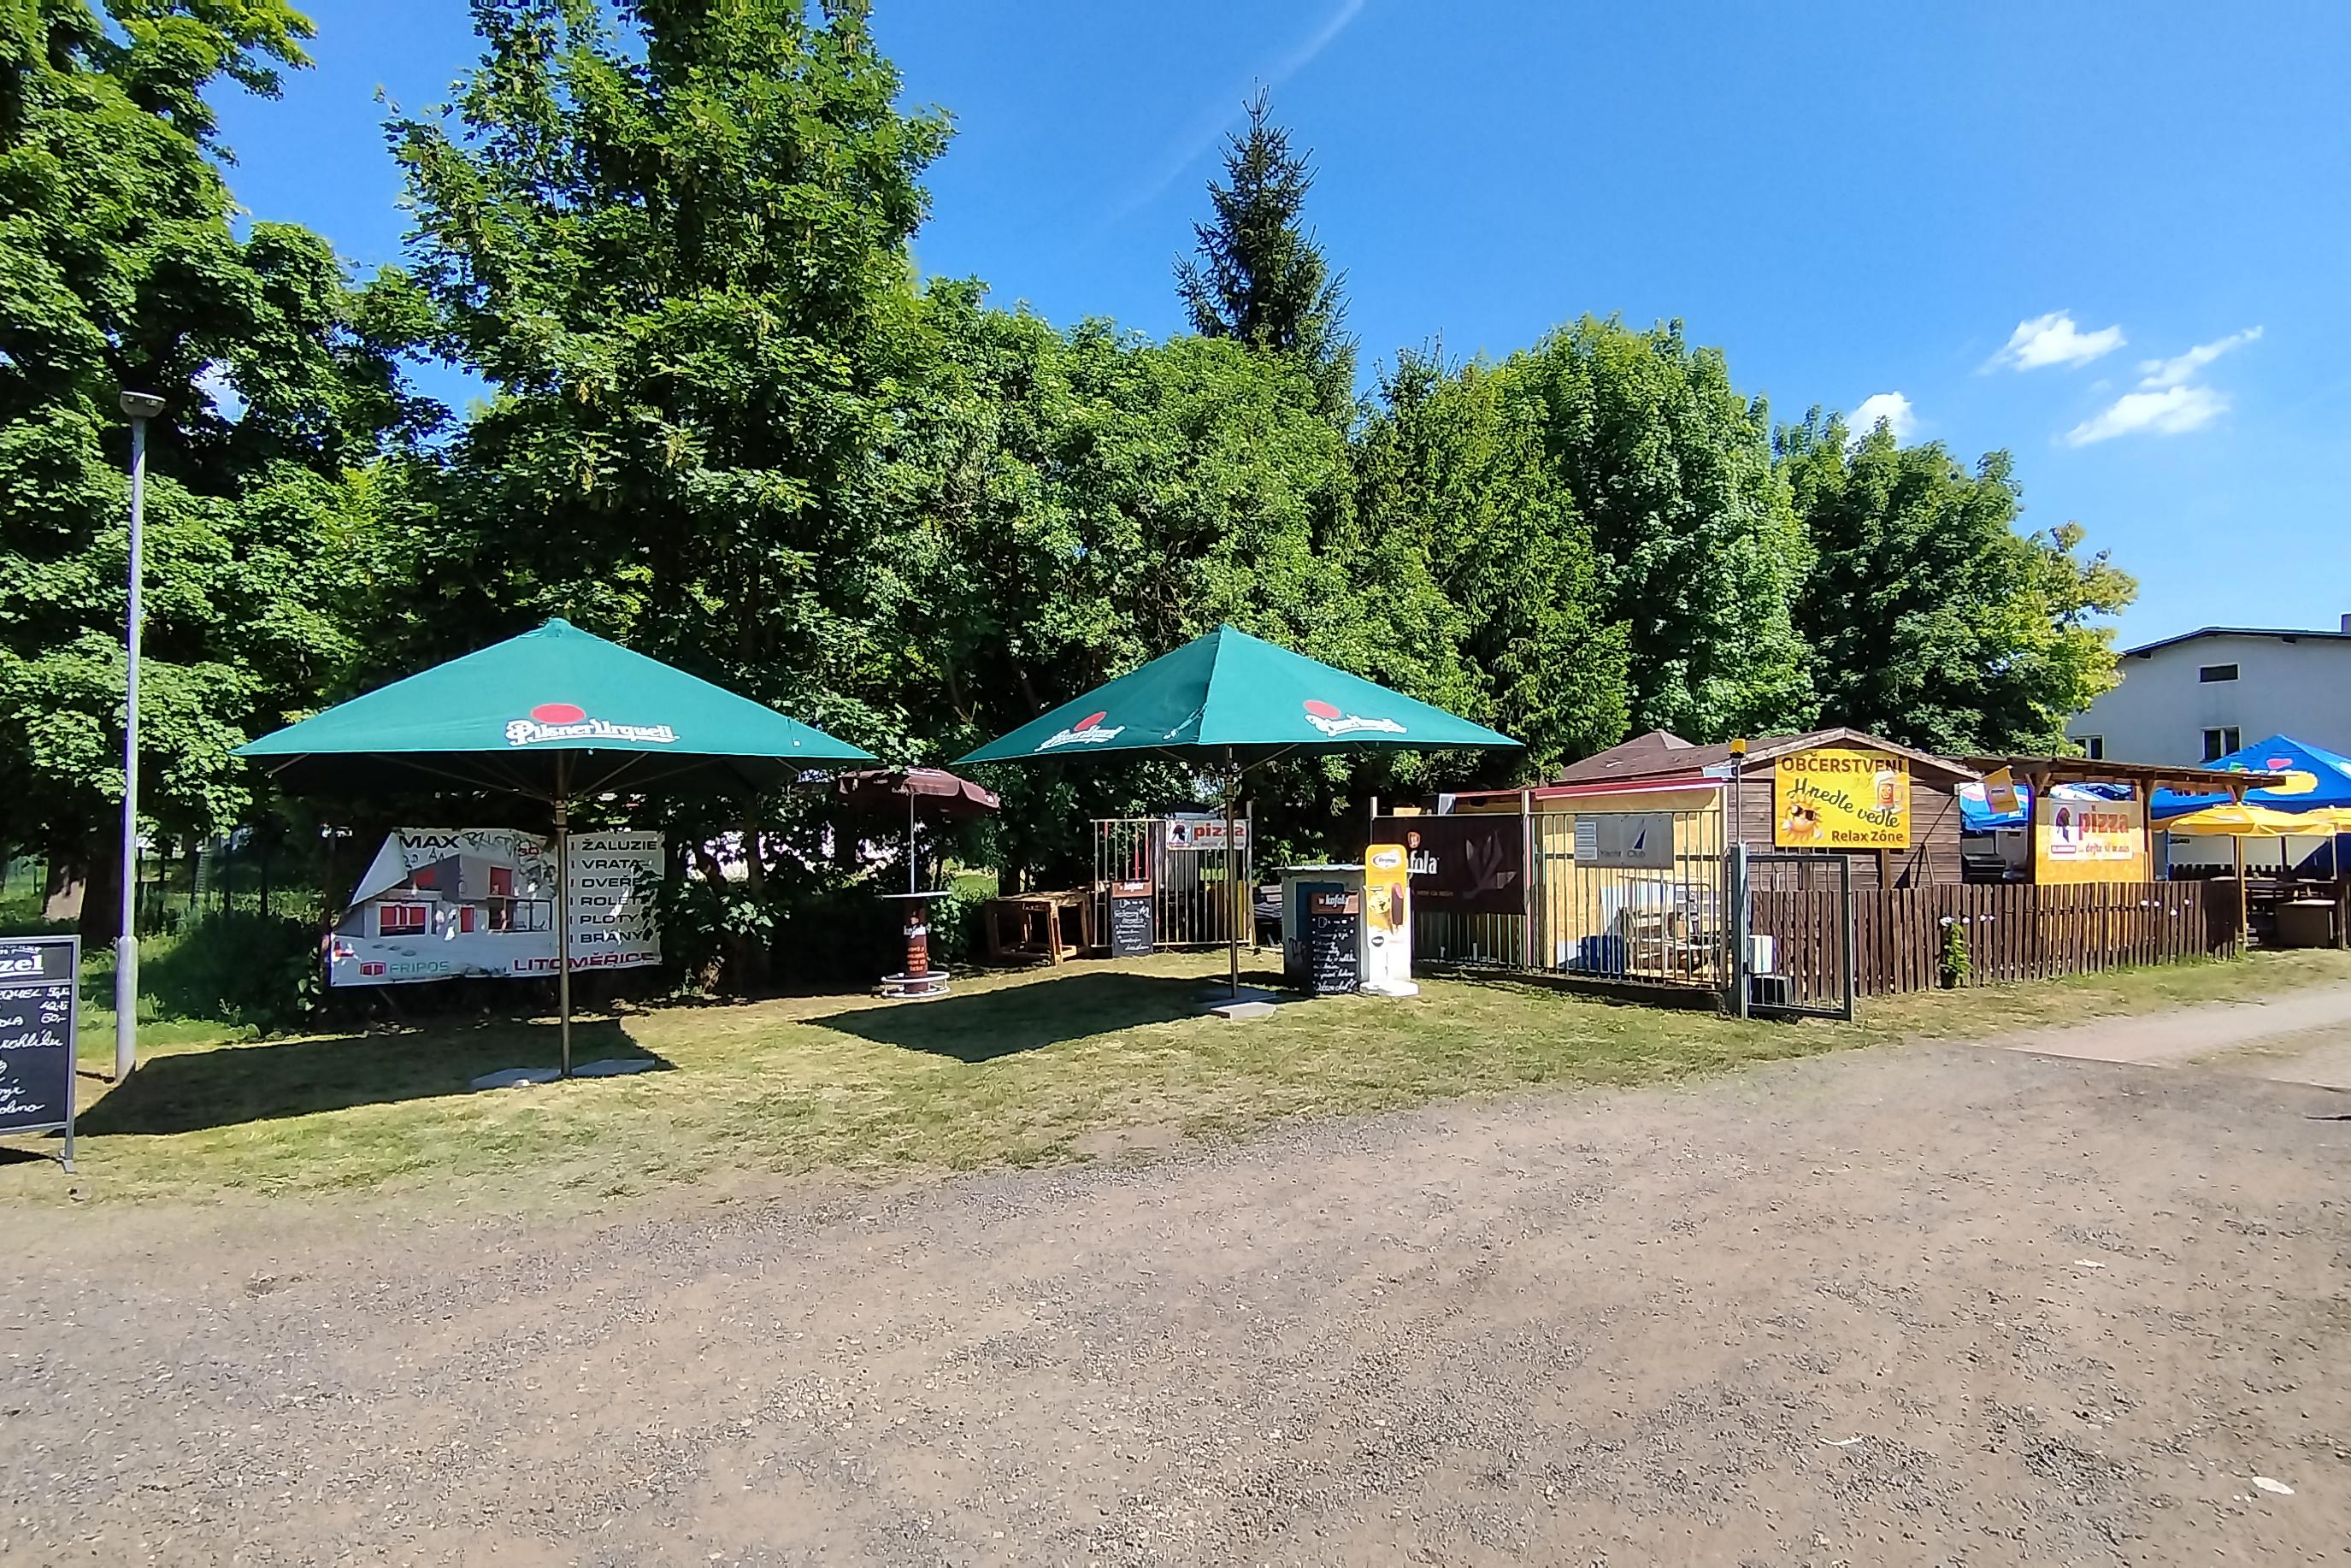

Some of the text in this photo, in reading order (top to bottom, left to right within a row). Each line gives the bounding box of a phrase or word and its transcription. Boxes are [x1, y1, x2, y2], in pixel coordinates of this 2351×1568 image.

[506, 718, 681, 746] Pilsner Urquell
[1782, 753, 1903, 773] OBČERSTVENÍ
[1787, 778, 1854, 813] Hnedle
[1858, 809, 1900, 828] vedle
[2078, 805, 2130, 840] pizza
[399, 835, 459, 848] MAX
[1832, 829, 1904, 842] Relax Zóne
[581, 838, 657, 851] ŽALUZIE
[1407, 850, 1437, 880] fola
[580, 896, 647, 906] ROLET
[580, 914, 639, 924] PLOTY
[390, 961, 450, 973] FRIPOS
[0, 989, 42, 999] QUEL
